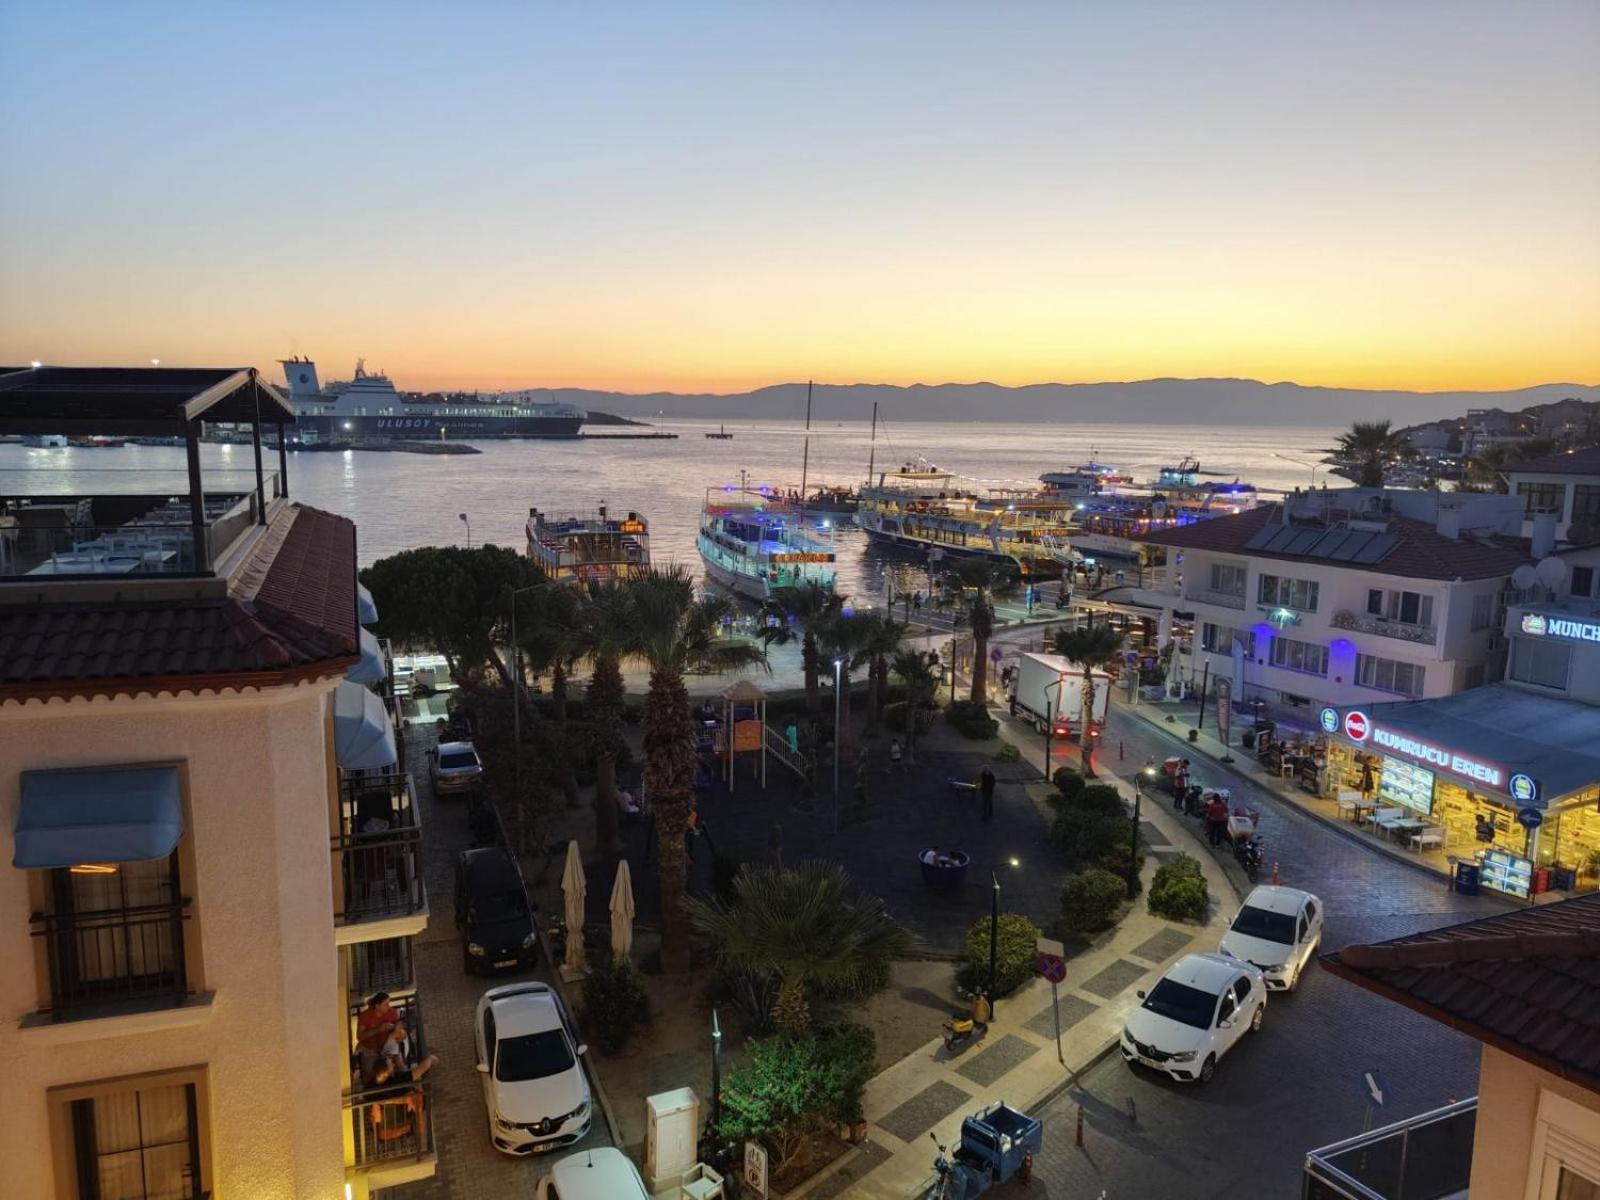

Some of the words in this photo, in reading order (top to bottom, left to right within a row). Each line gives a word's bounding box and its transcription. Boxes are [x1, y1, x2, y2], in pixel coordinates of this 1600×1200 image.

[377, 419, 431, 428] ULUSOY
[1548, 619, 1600, 641] MUNCH
[1452, 756, 1500, 785] EREN
